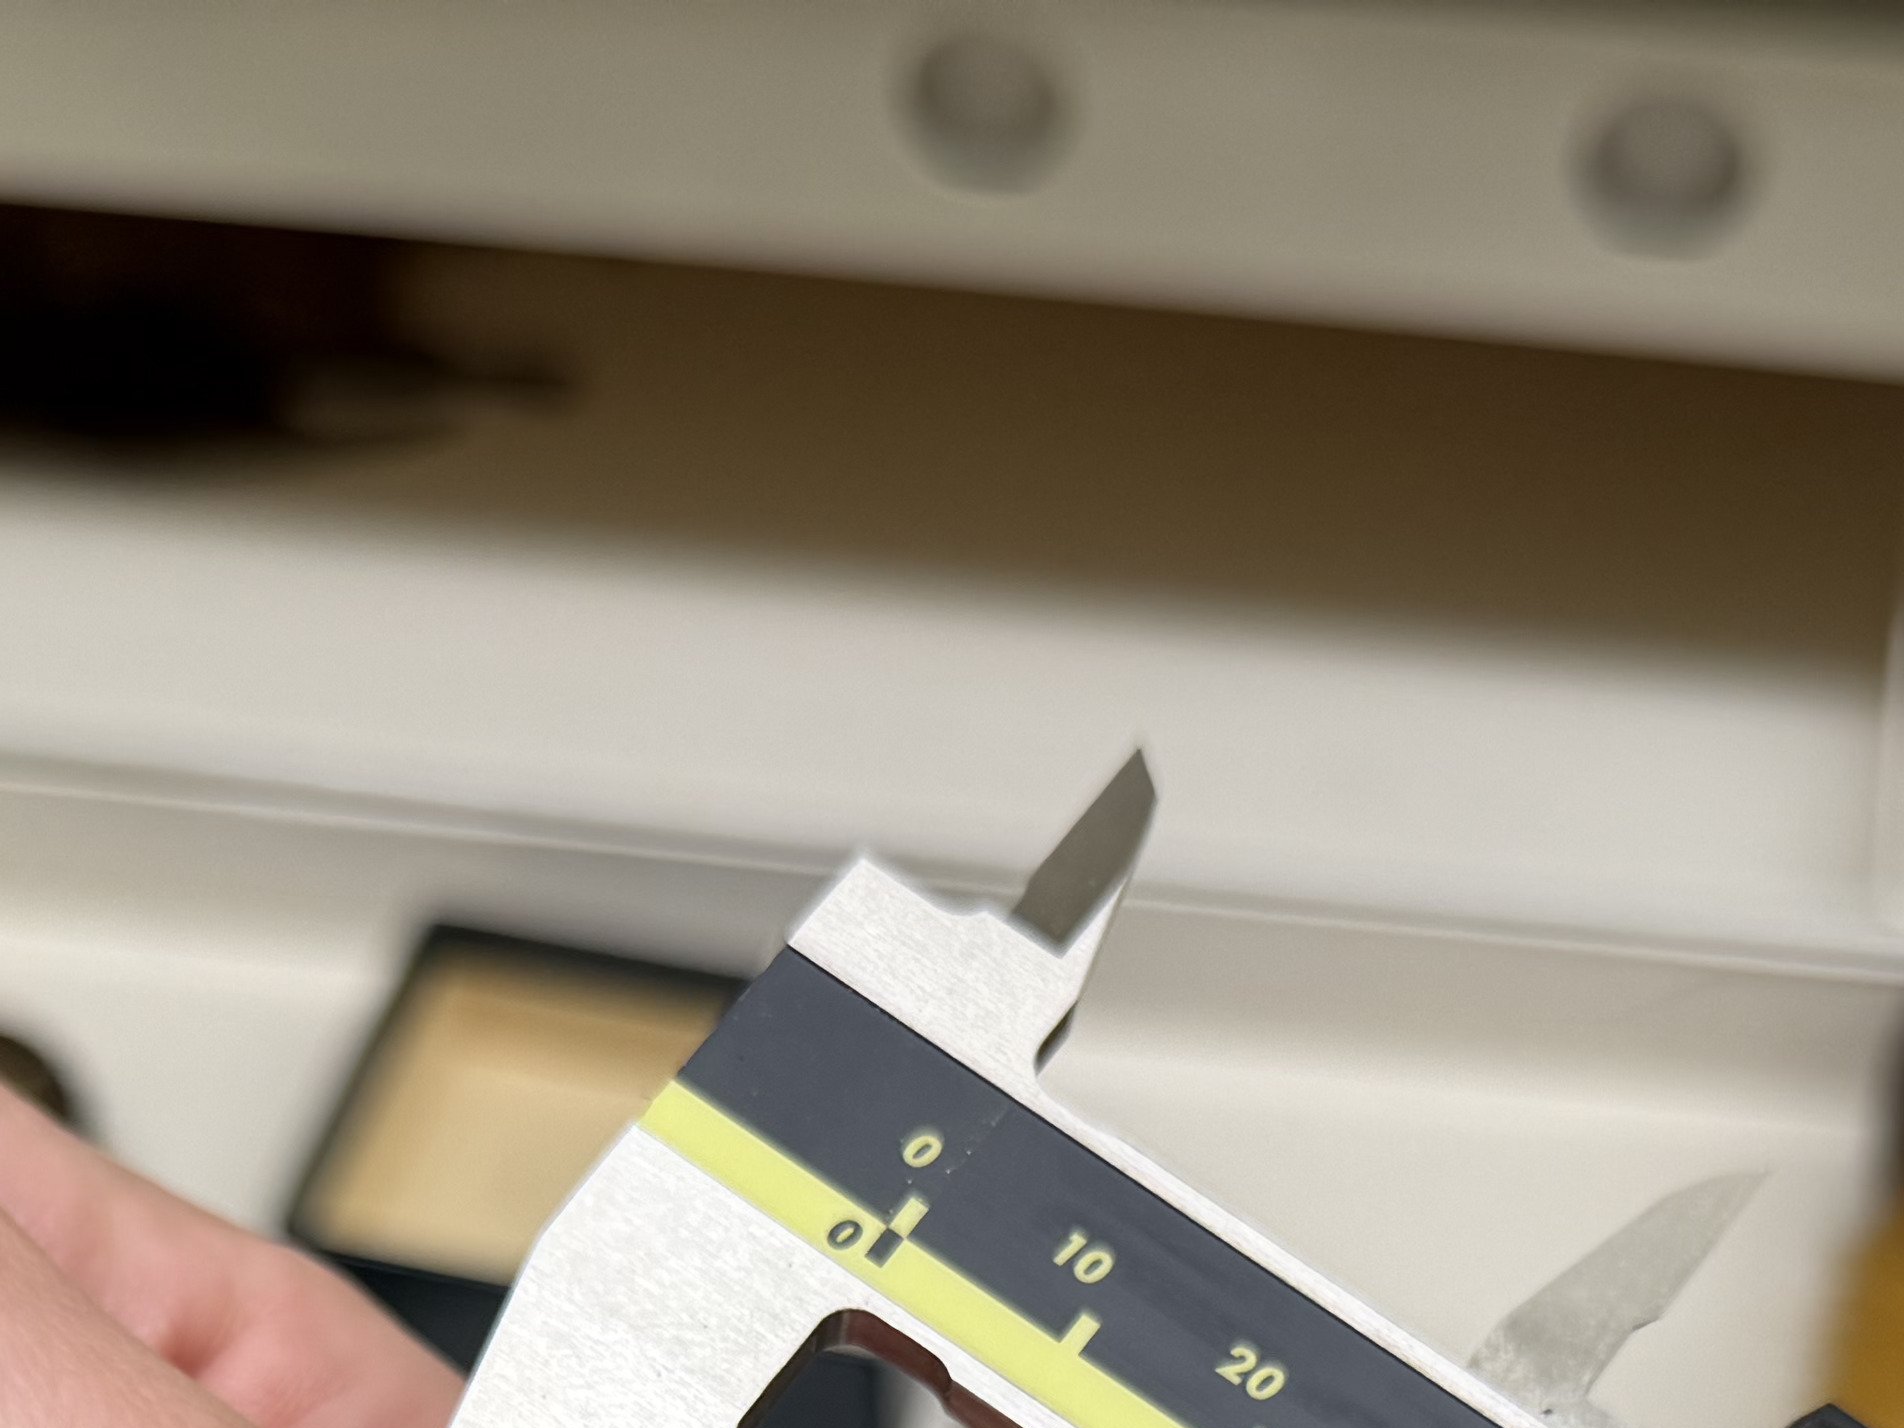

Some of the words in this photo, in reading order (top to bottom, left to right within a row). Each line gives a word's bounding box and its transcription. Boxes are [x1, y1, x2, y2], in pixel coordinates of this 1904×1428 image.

[903, 1136, 943, 1168] 0
[827, 1220, 864, 1251] 0
[1053, 1233, 1114, 1284] 10
[1214, 1345, 1286, 1400] 20
